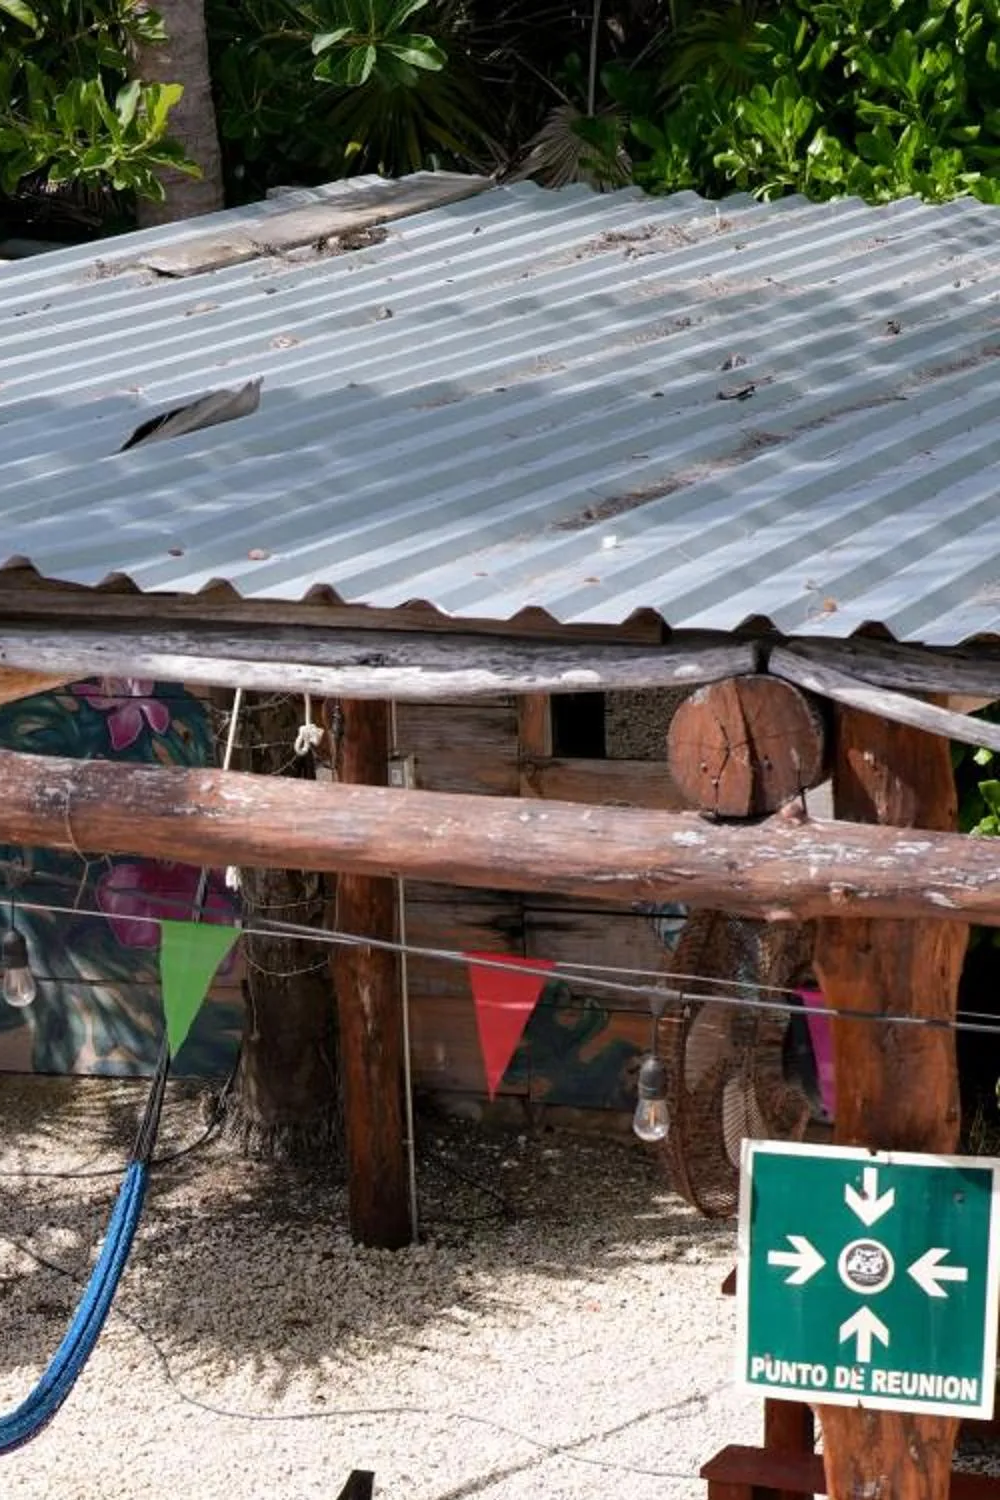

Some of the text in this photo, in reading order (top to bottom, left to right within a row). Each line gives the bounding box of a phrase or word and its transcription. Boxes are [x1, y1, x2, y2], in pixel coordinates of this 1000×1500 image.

[751, 1357, 977, 1400] PUNTO DE REUNION
